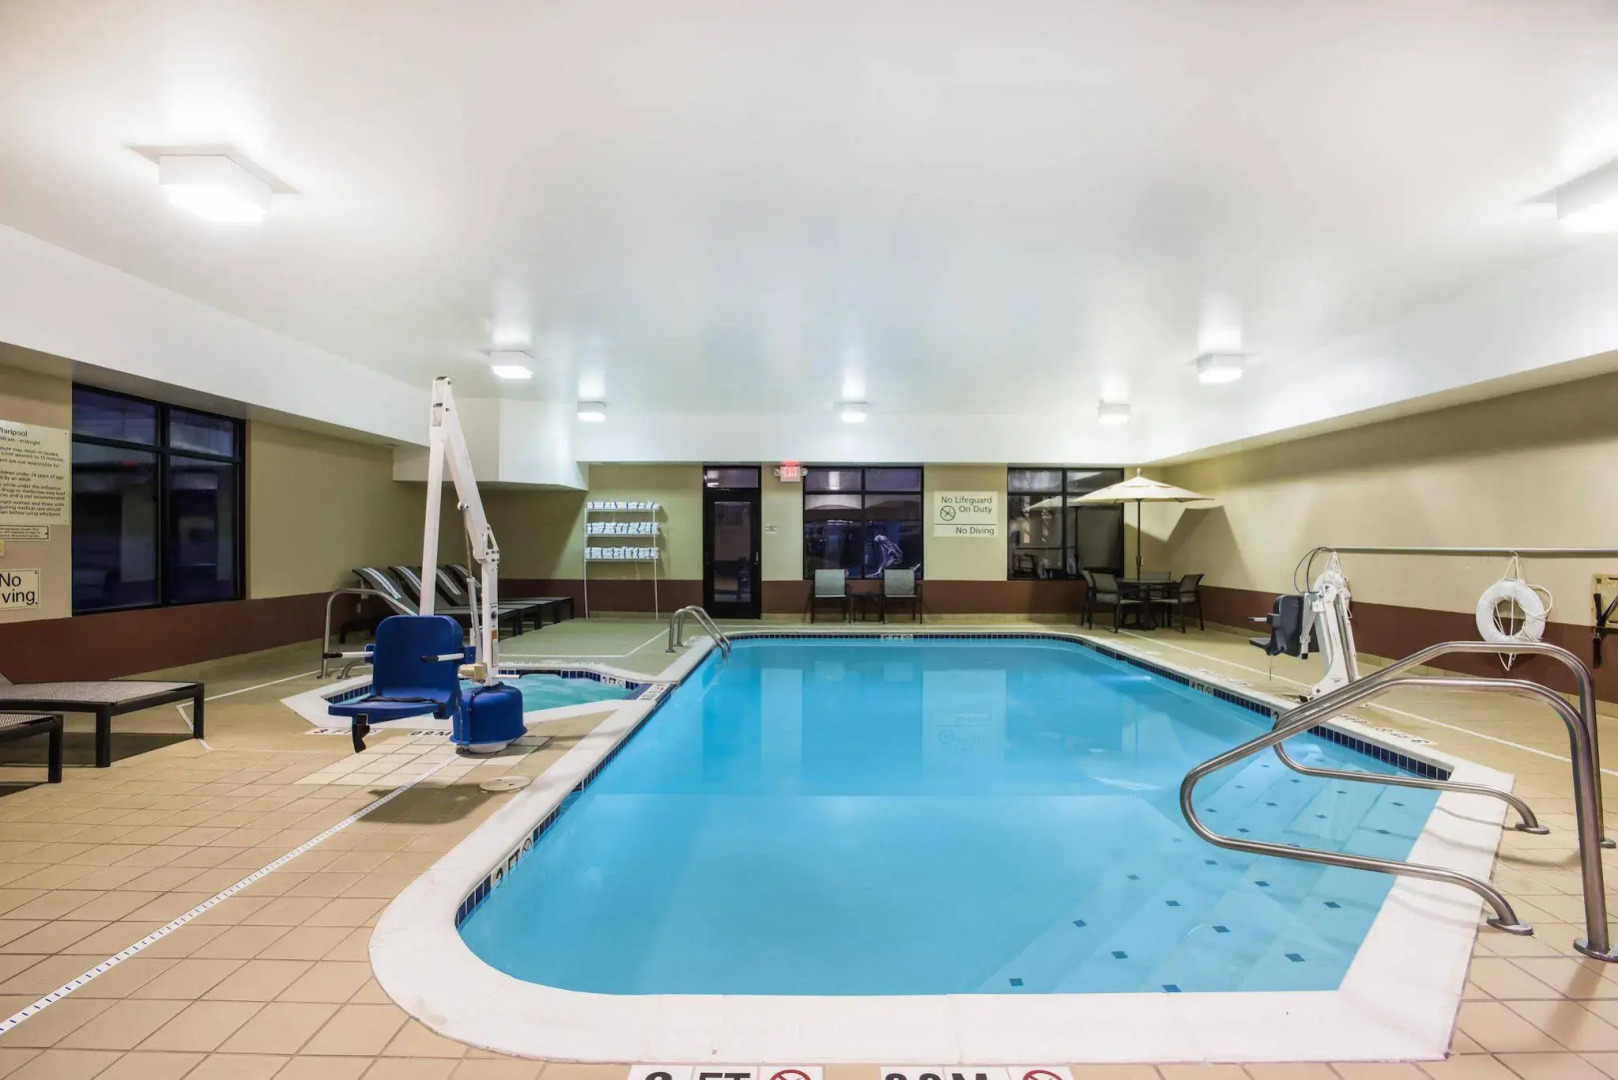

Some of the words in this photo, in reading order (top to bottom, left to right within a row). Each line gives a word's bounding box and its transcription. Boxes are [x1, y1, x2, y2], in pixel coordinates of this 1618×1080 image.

[941, 496, 953, 504] No
[955, 496, 993, 505] Lifeguard
[959, 505, 971, 513] On
[973, 505, 993, 514] Duty
[970, 527, 995, 536] Diving
[0, 573, 22, 587] No
